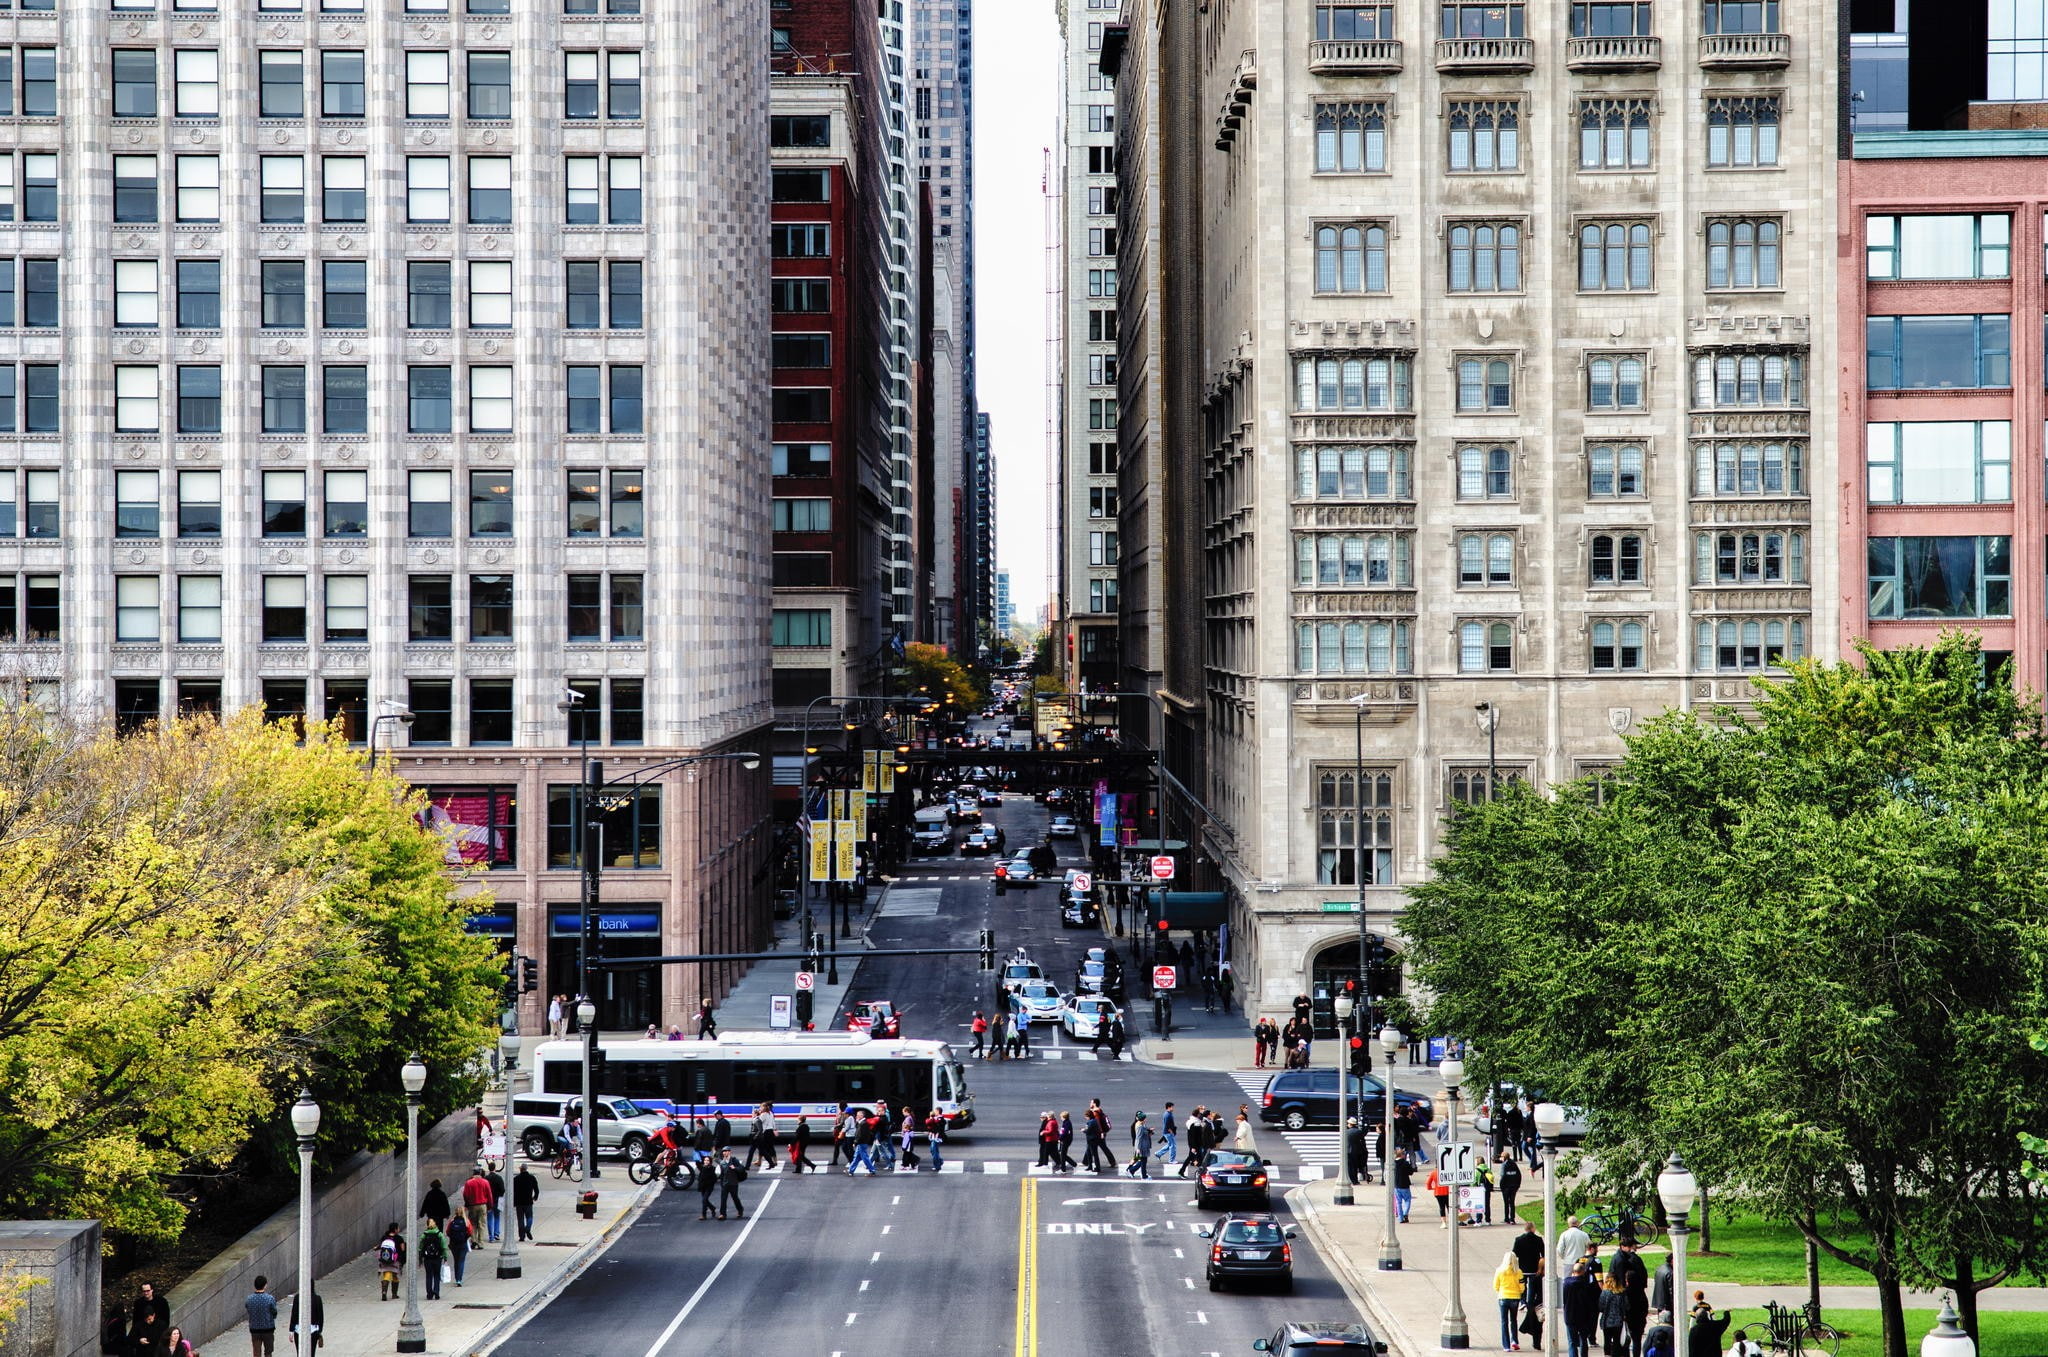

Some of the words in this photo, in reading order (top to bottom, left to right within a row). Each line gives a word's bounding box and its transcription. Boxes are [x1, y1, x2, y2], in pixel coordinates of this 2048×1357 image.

[1440, 1172, 1454, 1182] ONLY
[1459, 1171, 1473, 1181] ONLY
[1047, 1223, 1157, 1234] ONLY
